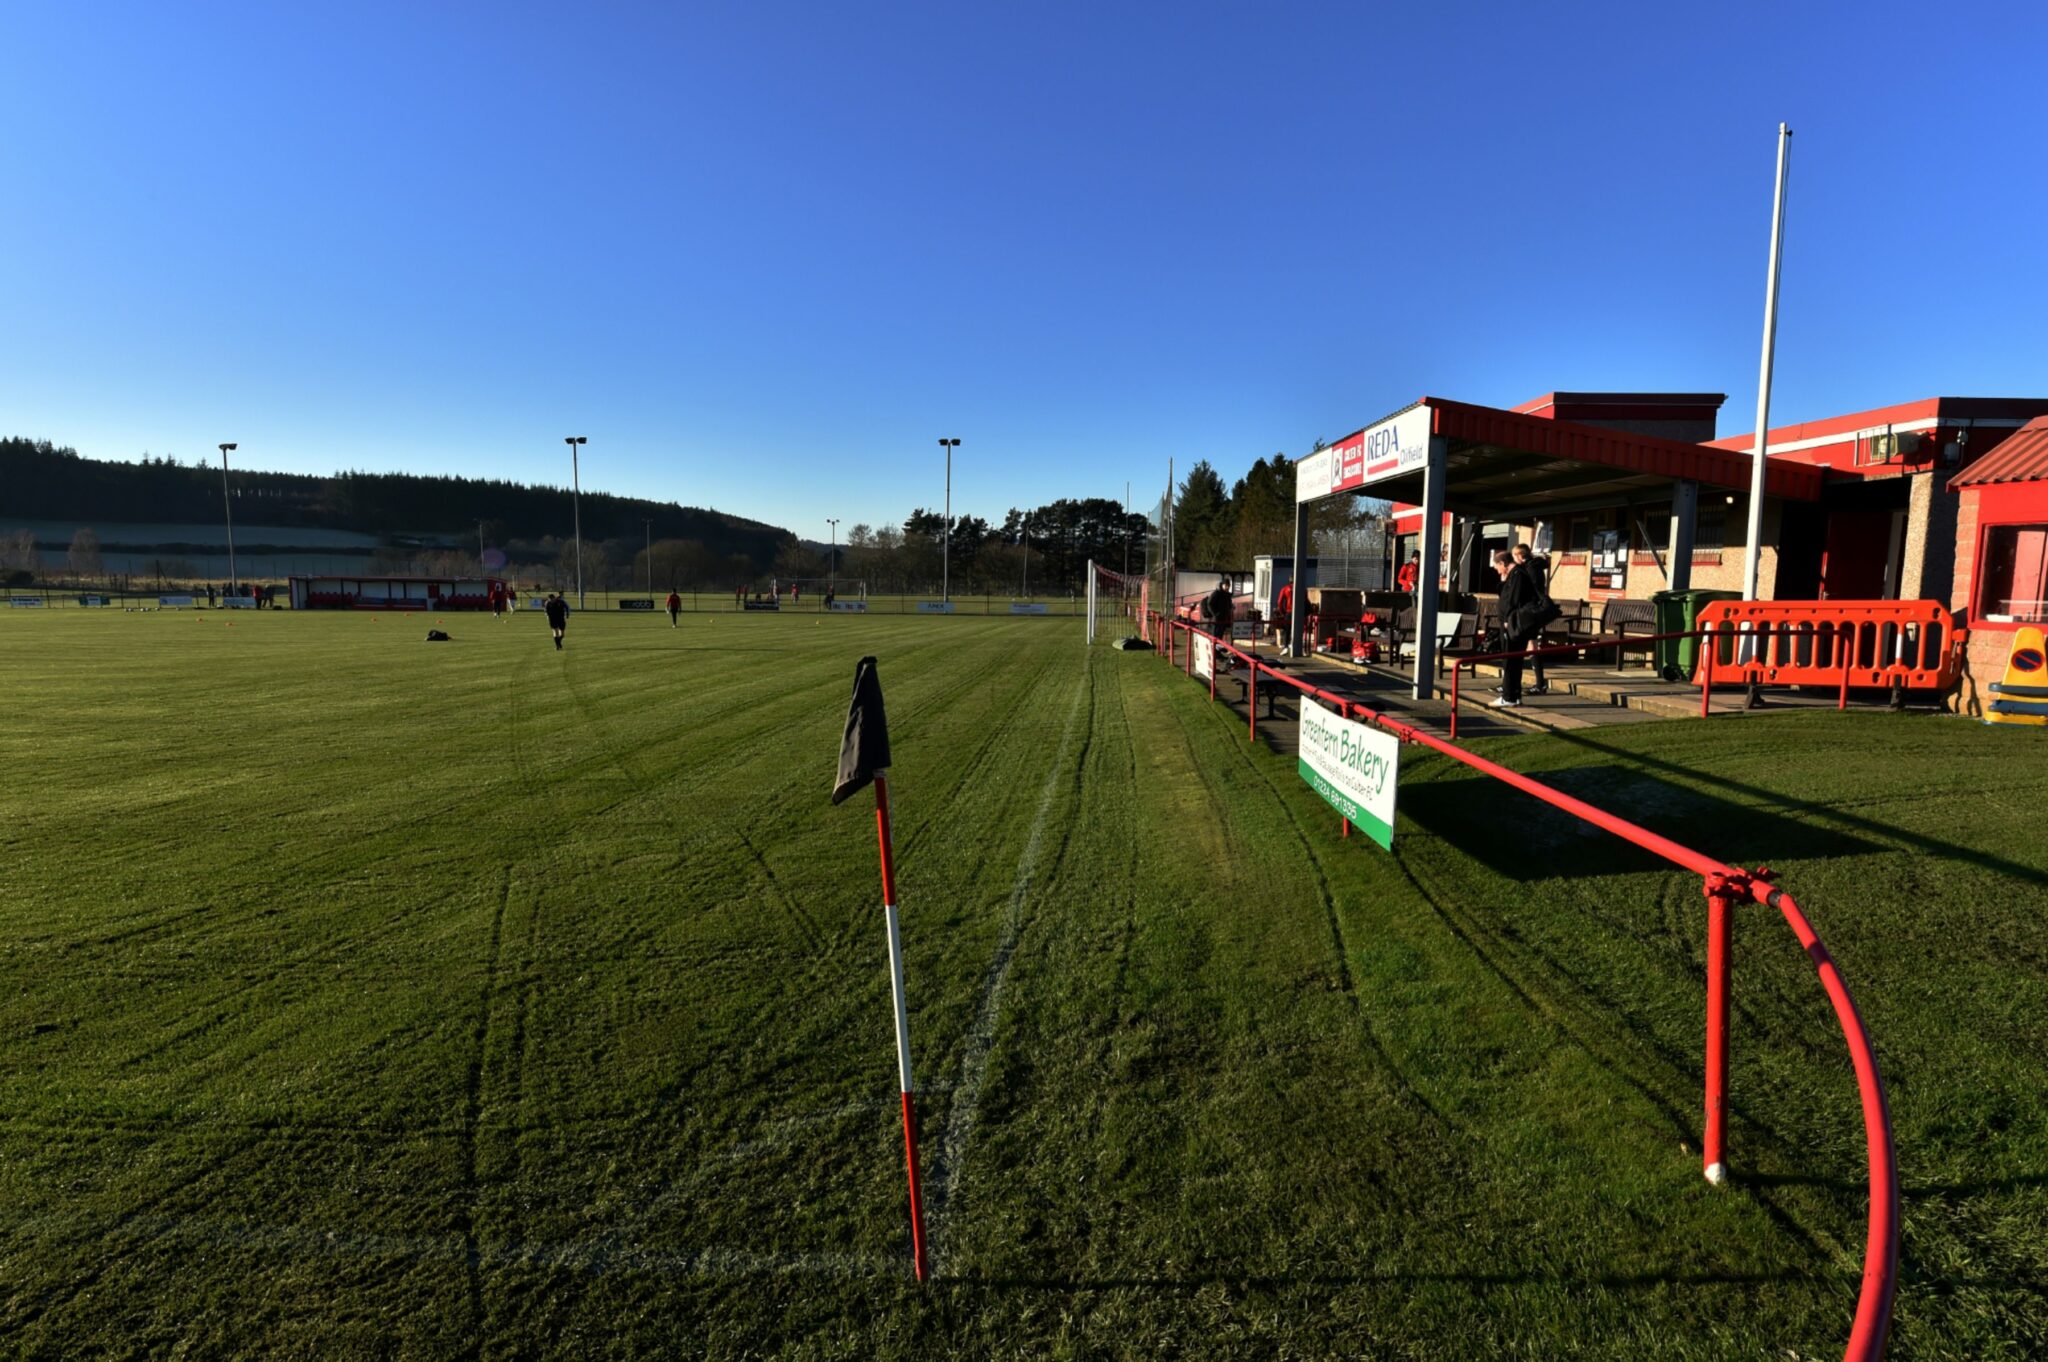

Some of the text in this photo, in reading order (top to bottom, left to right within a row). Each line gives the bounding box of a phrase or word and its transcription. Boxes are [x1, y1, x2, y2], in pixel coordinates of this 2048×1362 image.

[1367, 424, 1399, 461] REDA
[1400, 443, 1423, 465] Oilfield
[1302, 706, 1338, 759] Greenfern
[1340, 729, 1390, 794] Bakery
